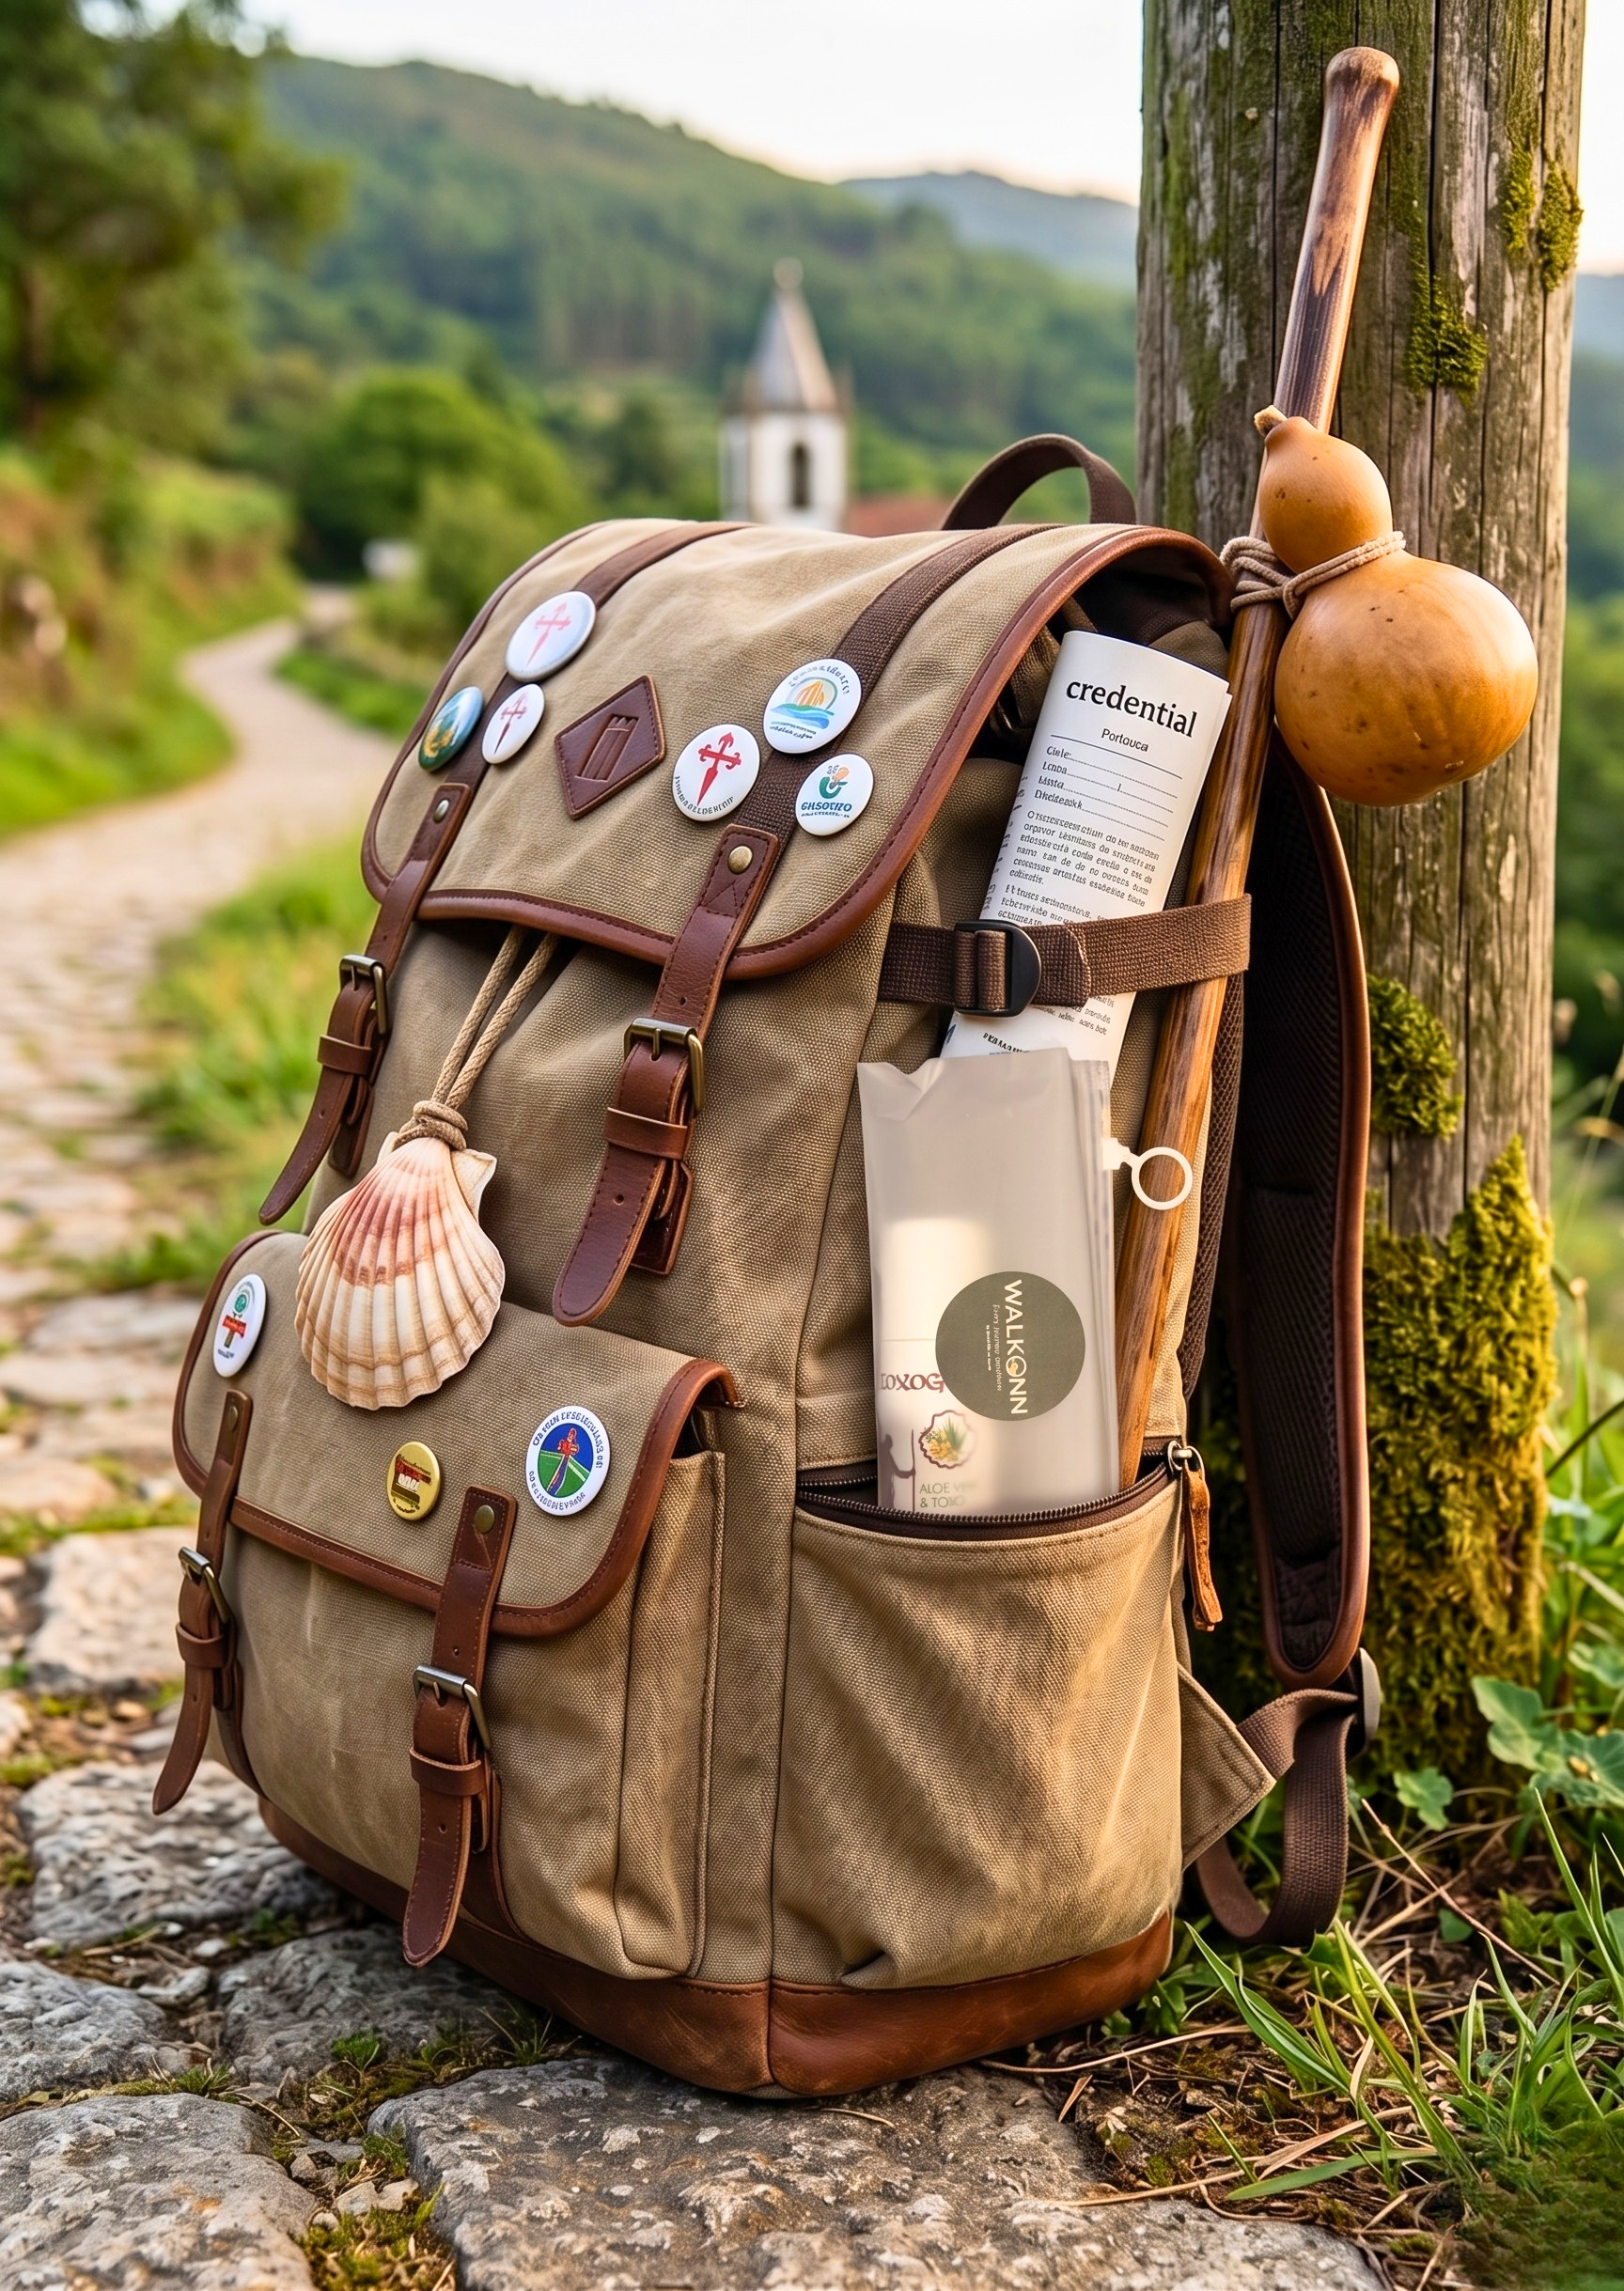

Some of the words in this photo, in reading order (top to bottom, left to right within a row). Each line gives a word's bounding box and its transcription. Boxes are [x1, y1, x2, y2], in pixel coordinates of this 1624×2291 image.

[1066, 681, 1197, 738] credential
[1004, 1279, 1028, 1414] WALKONN
[919, 1482, 950, 1494] ALOE
